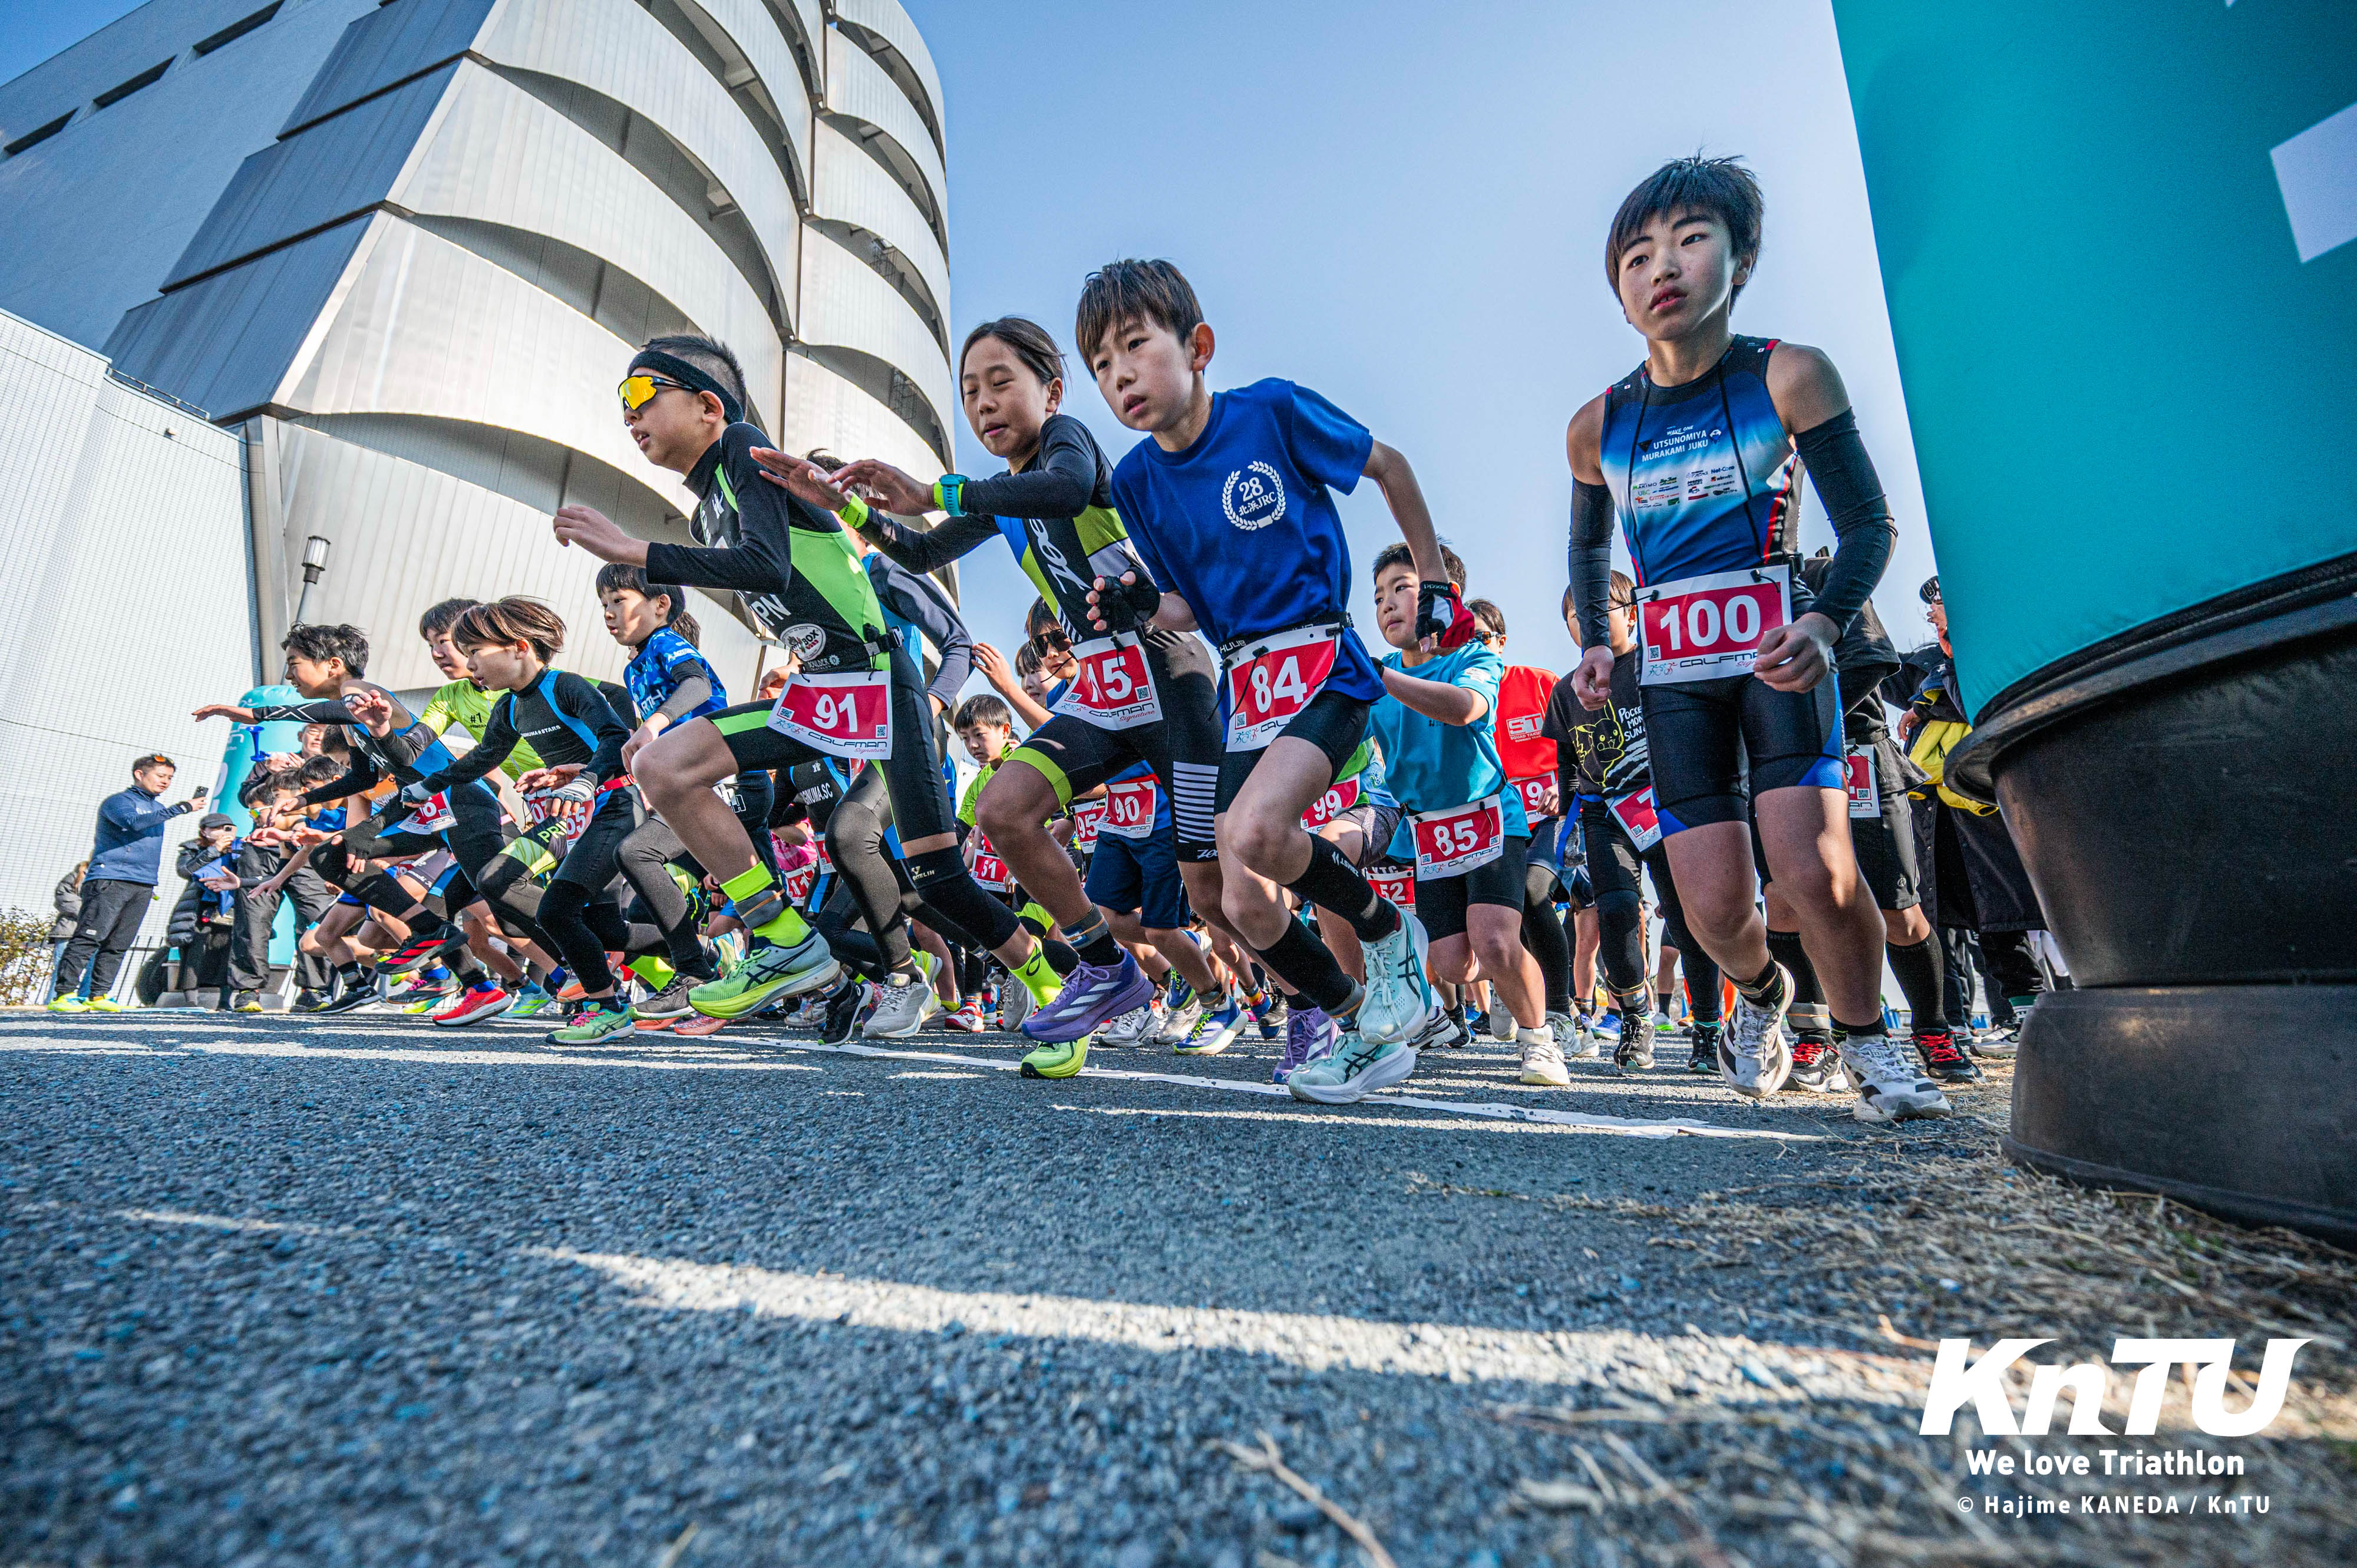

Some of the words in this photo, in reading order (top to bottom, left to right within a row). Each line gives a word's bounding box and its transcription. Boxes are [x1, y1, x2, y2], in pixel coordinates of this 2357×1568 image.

[1642, 445, 1685, 462] MURAKAMI
[1688, 439, 1708, 451] JUKU
[1653, 430, 1706, 450] UTSUNOMIYA
[1239, 477, 1263, 501] 28
[750, 594, 791, 629] PN
[1661, 595, 1761, 651] 100
[801, 629, 819, 646] BOX
[1220, 640, 1247, 653] HUUB
[1680, 652, 1758, 668] CALFM
[1087, 656, 1132, 702] 15
[1251, 655, 1308, 714] 84
[470, 712, 482, 724] #1
[812, 694, 858, 733] 91
[1119, 710, 1156, 722] Signature
[1618, 706, 1643, 724] POCKE
[1623, 729, 1642, 741] SUN
[1114, 795, 1140, 823] 90
[1313, 790, 1342, 821] 99
[1077, 813, 1098, 839] 95
[1434, 820, 1478, 856] 85
[981, 860, 997, 879] 51
[1379, 882, 1406, 902] 52
